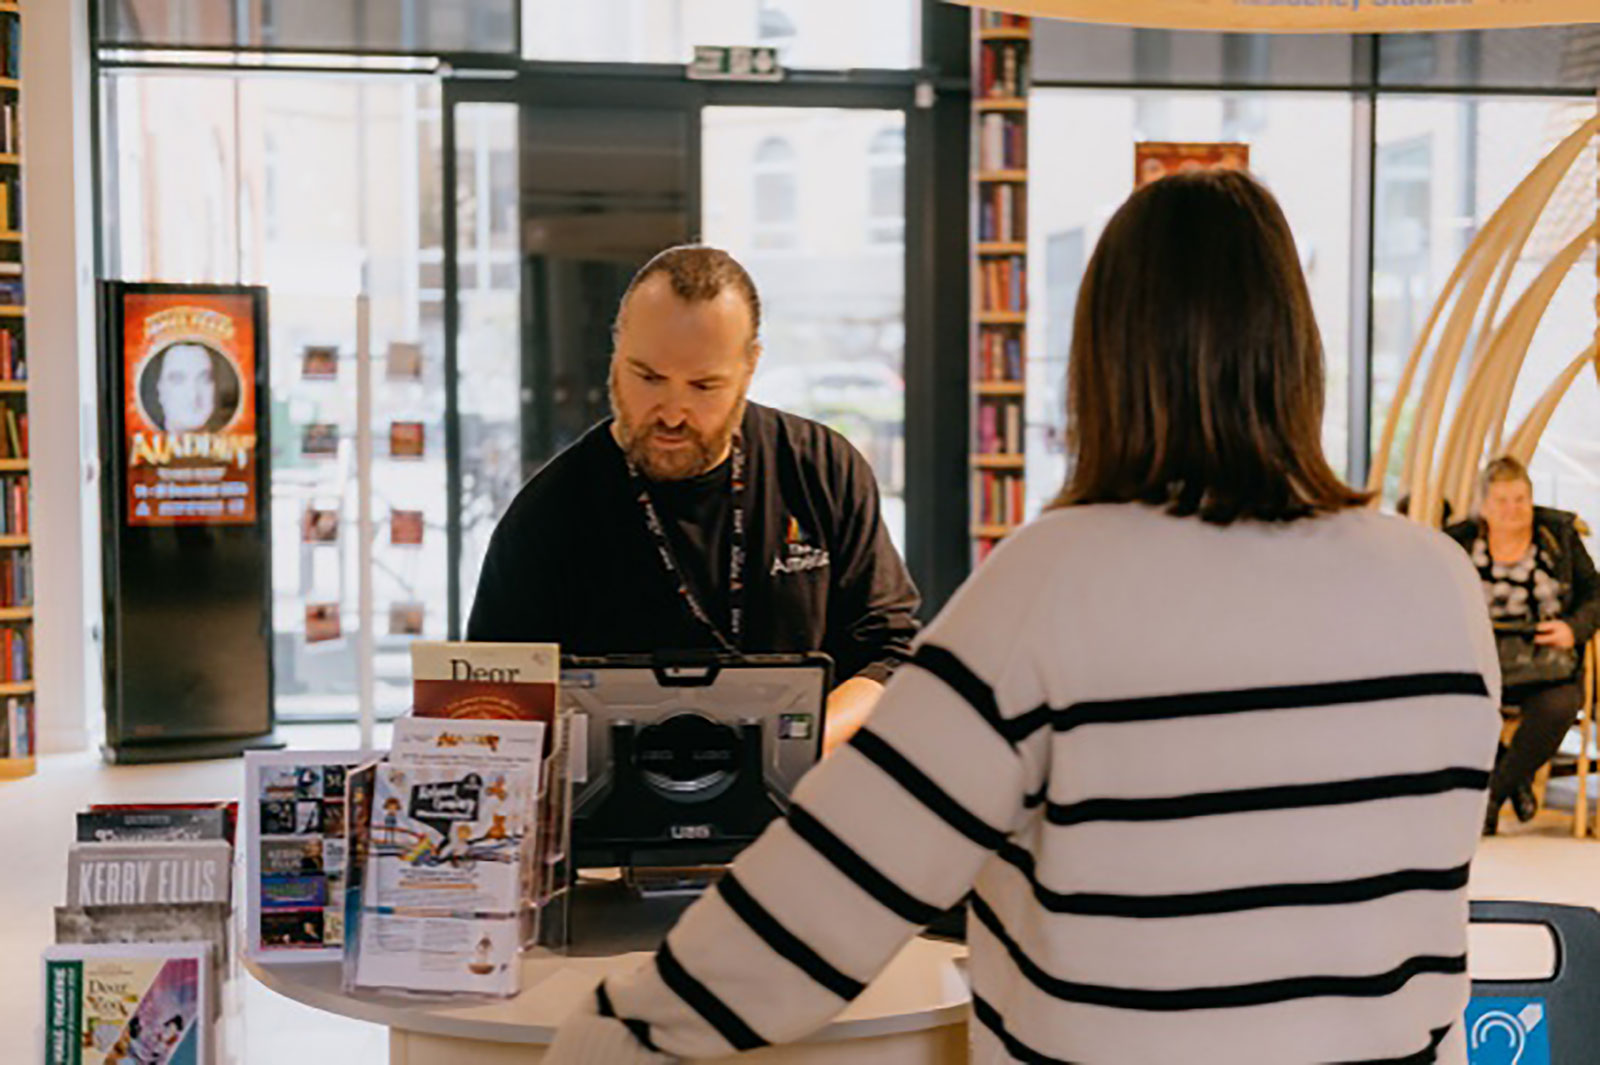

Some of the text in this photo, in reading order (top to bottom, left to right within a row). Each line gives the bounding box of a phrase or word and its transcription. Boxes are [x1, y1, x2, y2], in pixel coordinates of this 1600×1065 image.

[450, 658, 520, 683] Dear
[79, 861, 150, 905] KERRY
[158, 859, 217, 903] ELLIS
